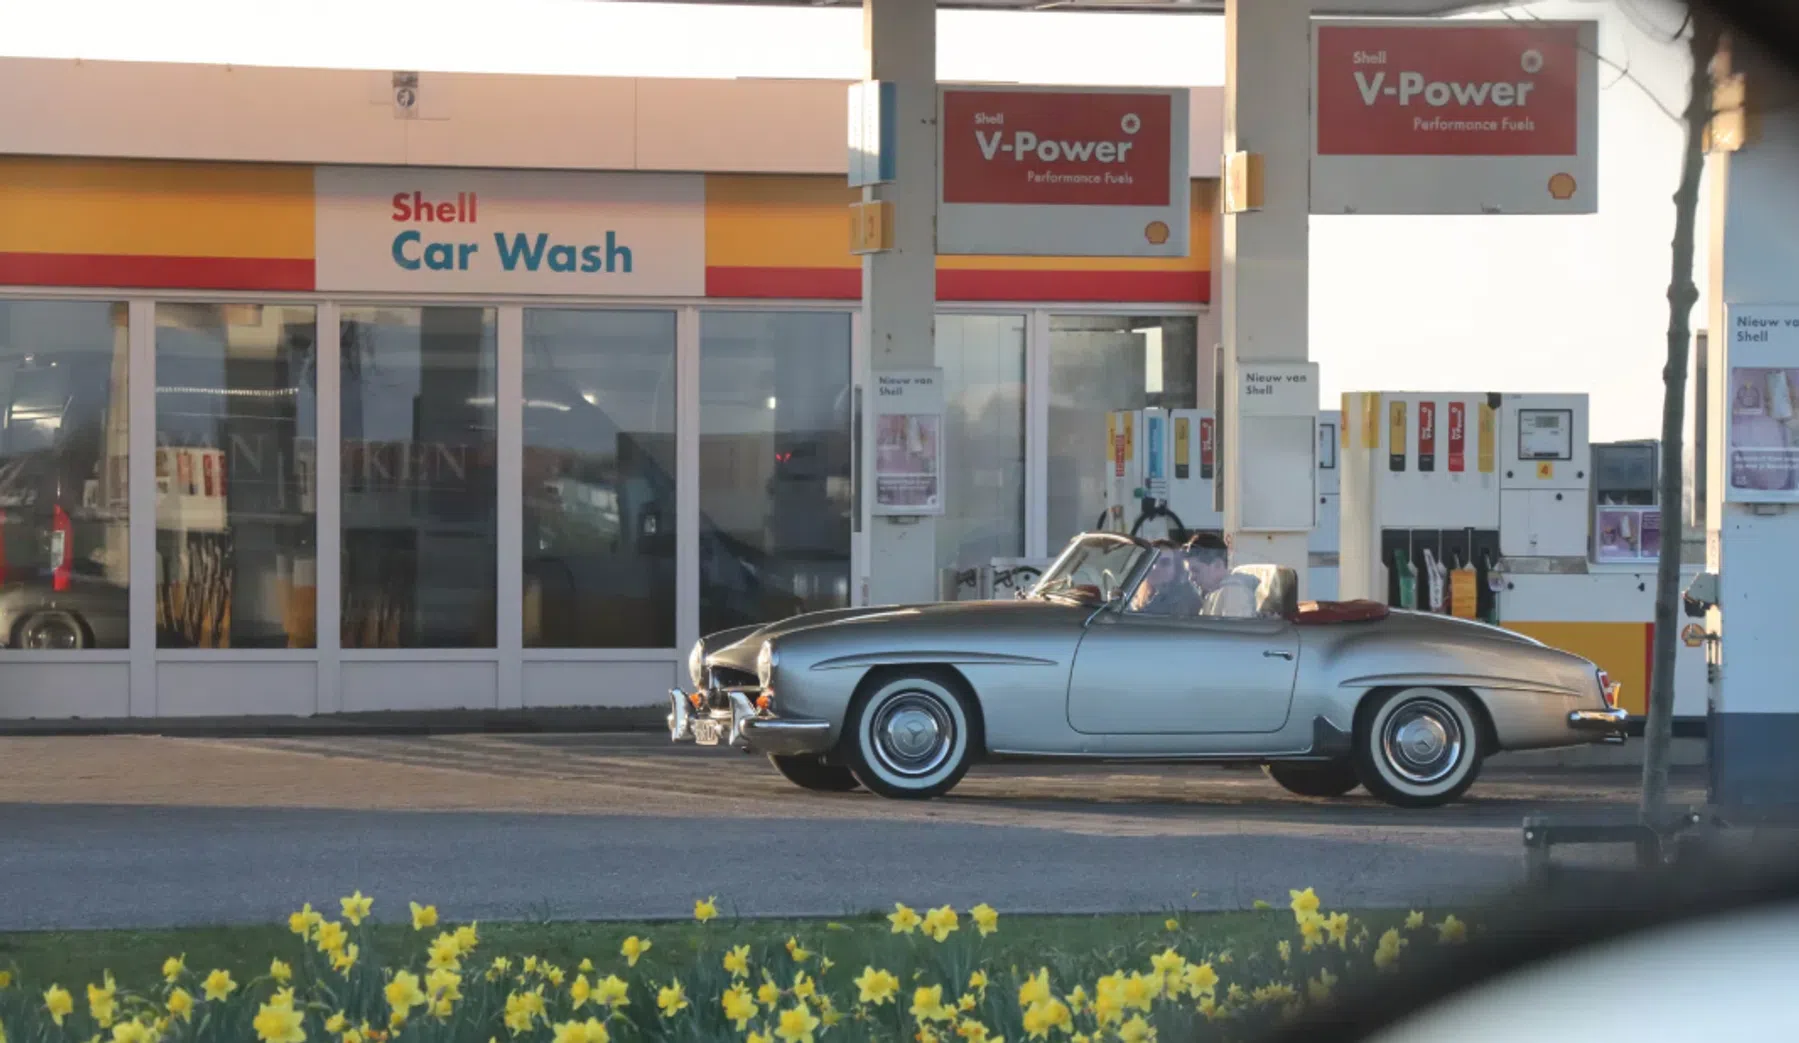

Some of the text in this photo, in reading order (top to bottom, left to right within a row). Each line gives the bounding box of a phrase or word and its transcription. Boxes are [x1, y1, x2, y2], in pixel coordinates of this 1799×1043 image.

[1353, 50, 1387, 64] Shell
[1353, 71, 1534, 107] V-Power
[975, 112, 1004, 125] Shell
[1413, 117, 1535, 131] Performance Fuels
[975, 131, 1133, 163] V-Power
[1027, 170, 1134, 184] Performance Fuels
[391, 191, 477, 223] Shell
[391, 230, 633, 273] Car Wash
[1737, 315, 1779, 327] Nieuw
[1737, 330, 1769, 342] Shell
[879, 376, 933, 385] Nieuw van
[1245, 372, 1307, 383] Nieuw van
[879, 386, 903, 396] Shell
[1245, 384, 1273, 395] Shell
[1539, 464, 1549, 476] 4
